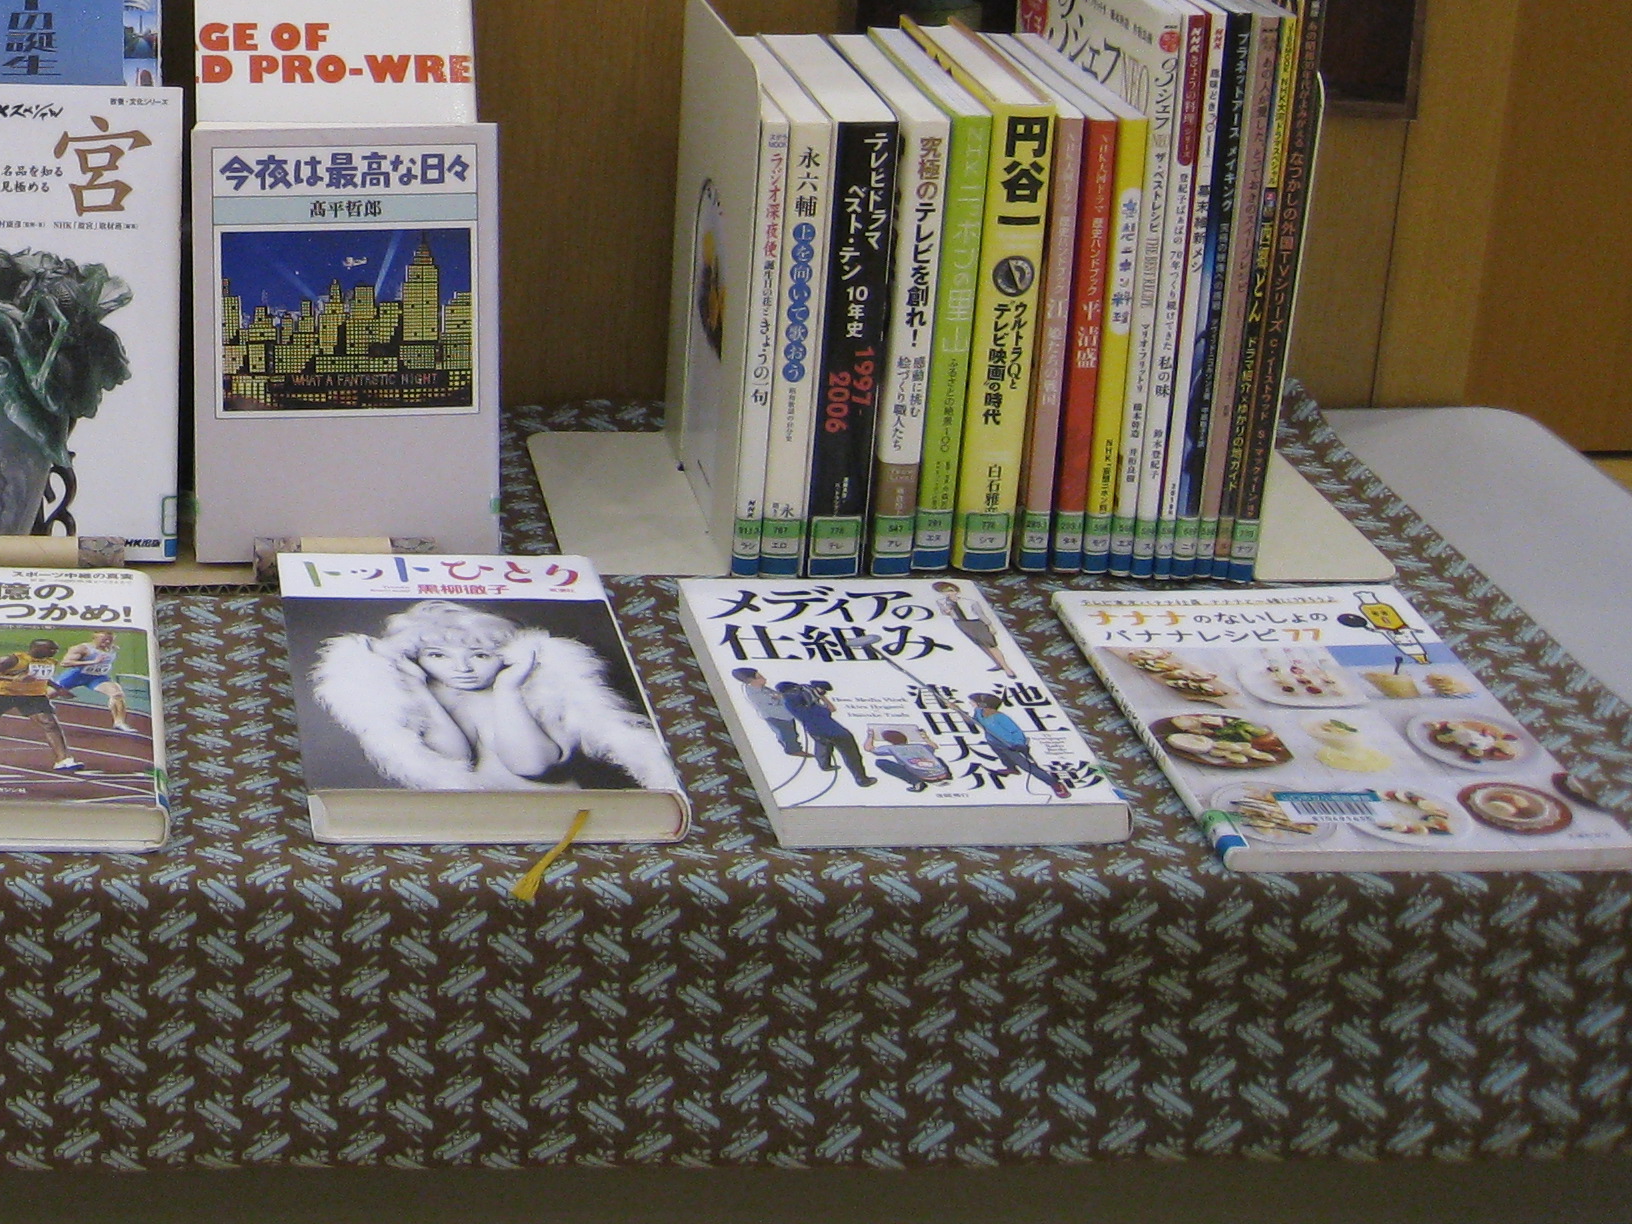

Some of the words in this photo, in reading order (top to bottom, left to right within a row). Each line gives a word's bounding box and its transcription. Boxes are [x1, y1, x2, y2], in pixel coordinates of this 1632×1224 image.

[270, 22, 330, 52] OF
[1230, 32, 1250, 139] プラネットアース
[52, 114, 153, 218] 宮
[219, 151, 471, 192] 今夜は最高な日々
[794, 145, 821, 218] 永六輔
[863, 131, 890, 252] テレビドラマ
[997, 115, 1049, 226] 円谷一
[1221, 146, 1239, 211] メイキング
[762, 152, 785, 259] ラジオ深夜便
[838, 182, 867, 281] ベスト・テン
[905, 135, 944, 348] 究極のテレビを創れ!
[783, 223, 816, 382] 上を向いて歌おう
[844, 285, 870, 339] 10年史
[1076, 298, 1102, 370] 平清盛
[337, 374, 396, 387] FANTASTIC
[1006, 301, 1028, 390] ウルトラQと
[1154, 356, 1173, 399] 私の味
[824, 370, 852, 435] 2006
[891, 355, 911, 452] 絵づくり職人たち
[909, 356, 926, 419] 感動に挑む
[302, 556, 580, 588] トットひとり
[416, 583, 510, 596] 黒柳徹子
[708, 585, 936, 624] メディアの
[719, 623, 954, 664] 仕組み
[906, 682, 1020, 791] 津田大介
